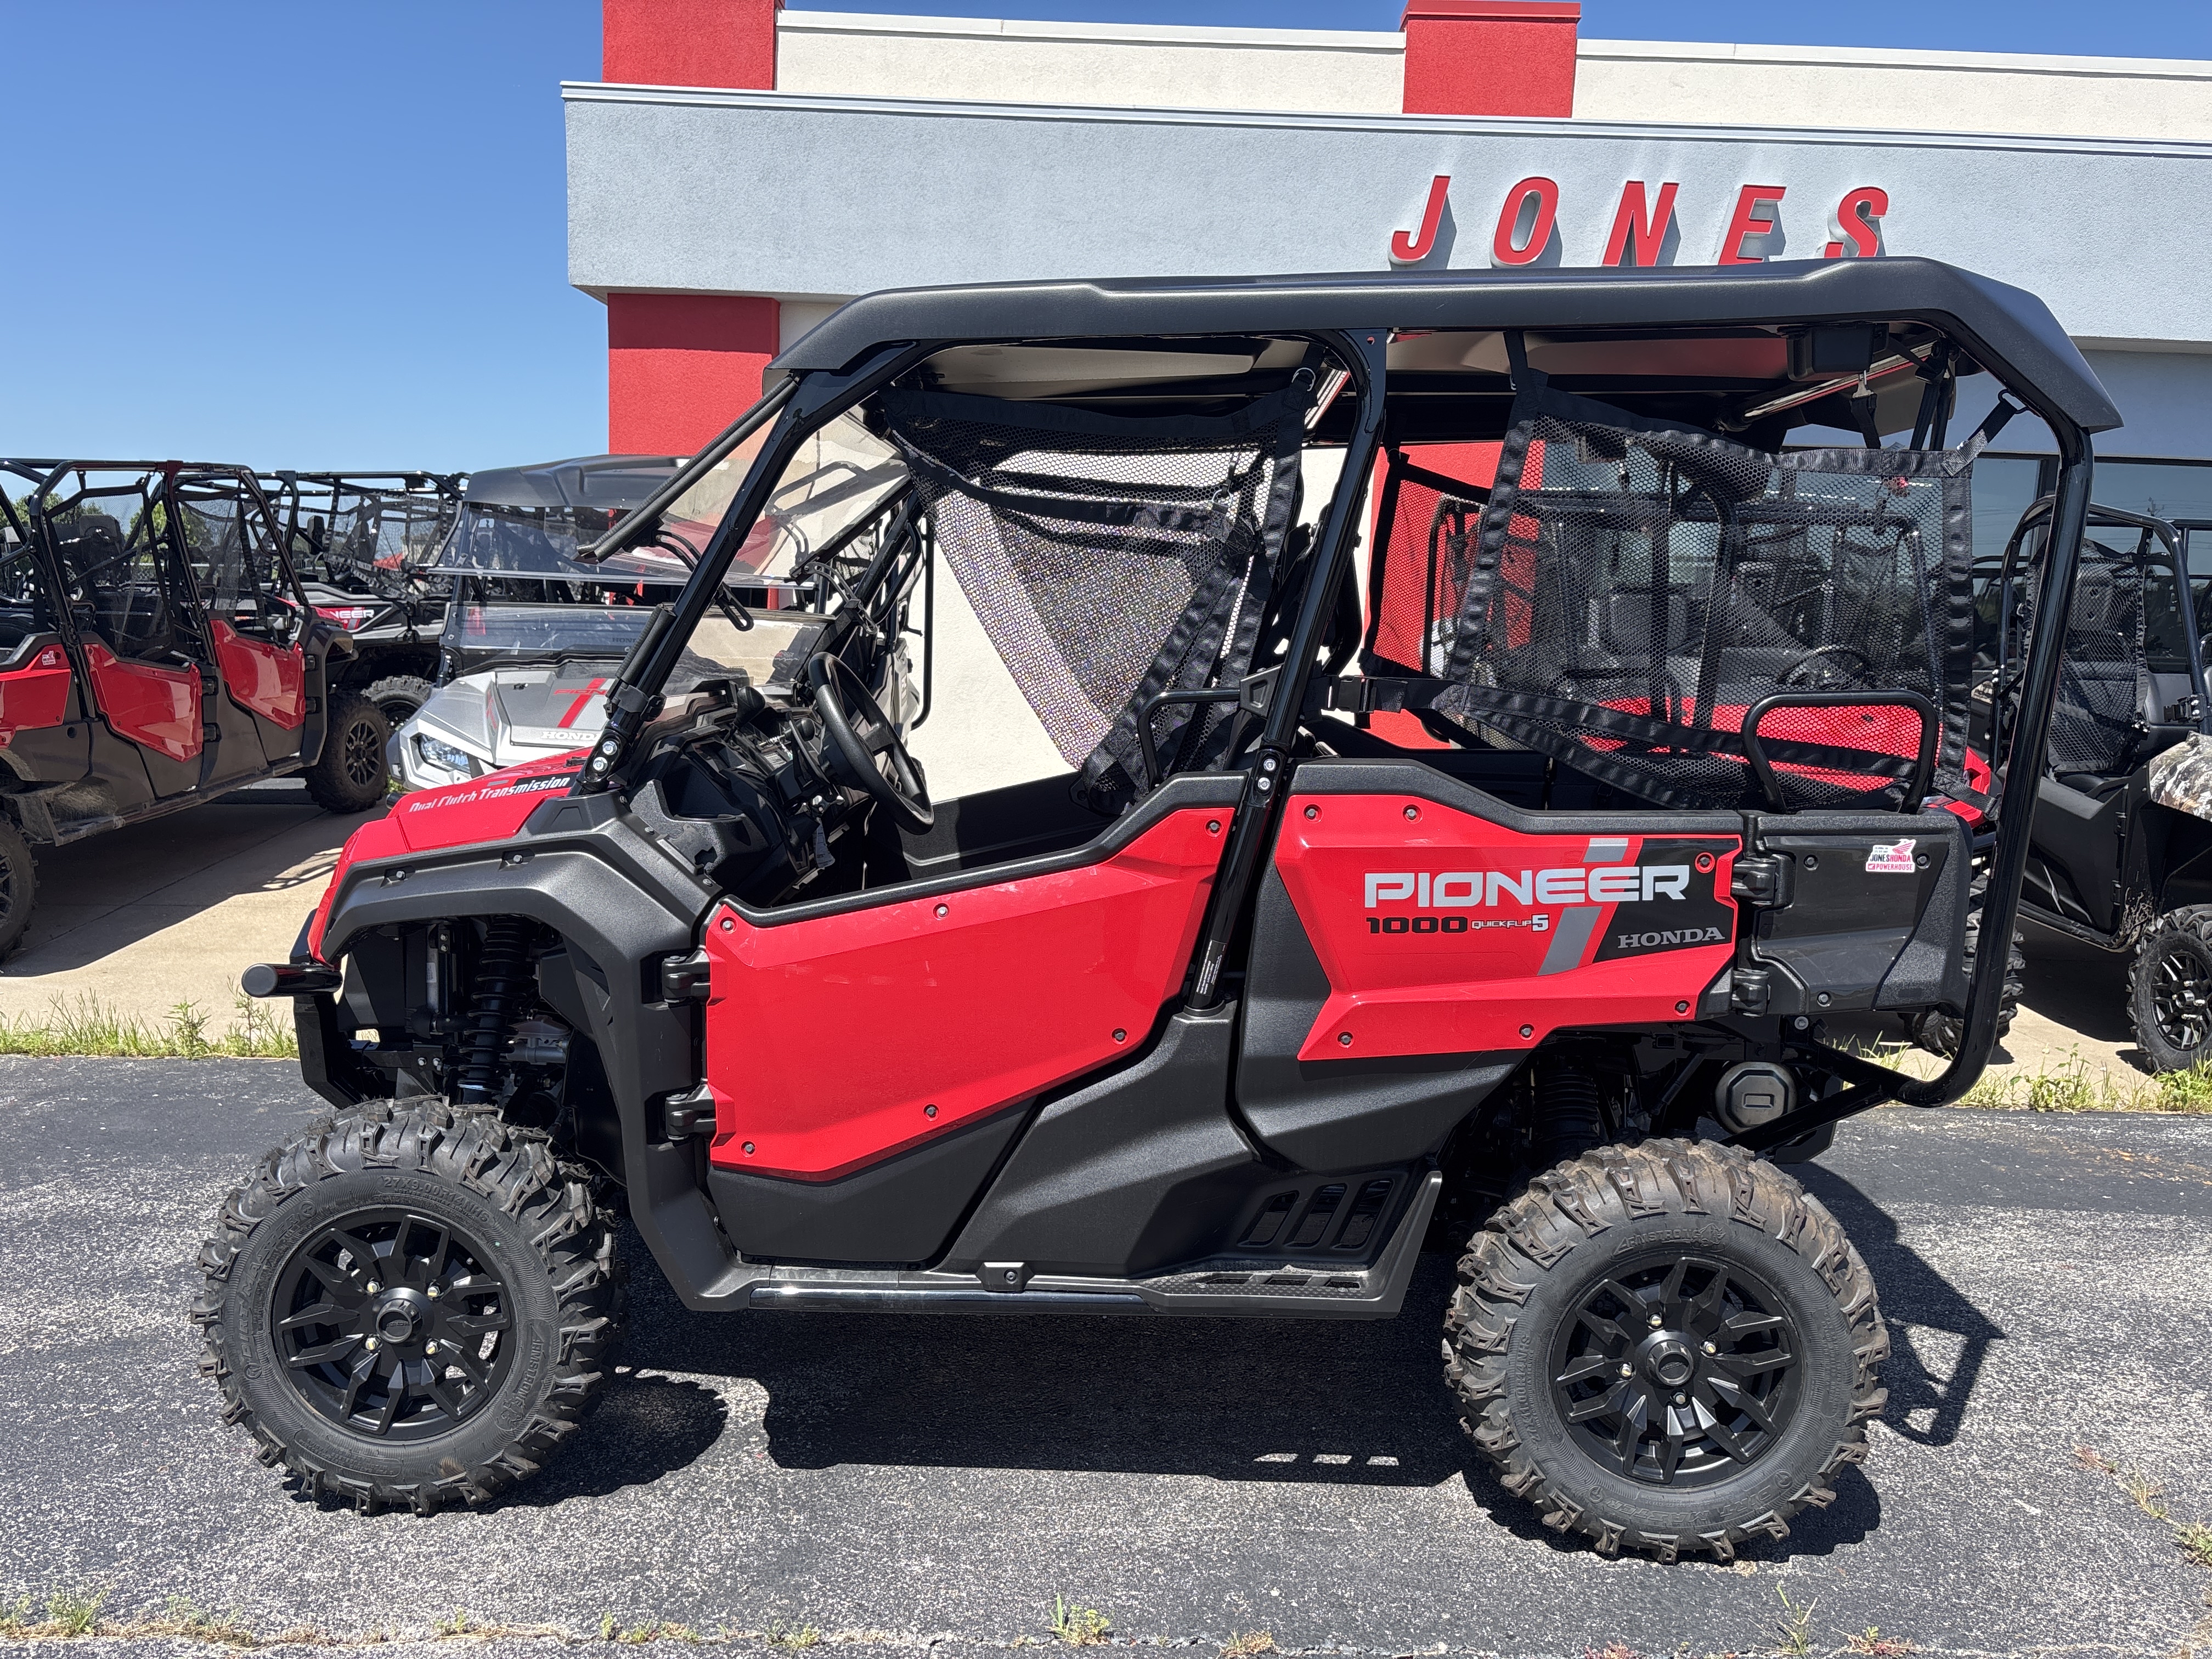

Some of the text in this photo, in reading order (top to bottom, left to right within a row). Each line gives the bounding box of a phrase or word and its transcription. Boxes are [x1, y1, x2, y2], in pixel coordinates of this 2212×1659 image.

[1391, 174, 1889, 266] JONES
[329, 609, 374, 619] NEER
[409, 776, 571, 812] Dual Clutch Transmission
[1364, 865, 1690, 908] PIONEER
[1367, 917, 1468, 934] 1000
[1617, 927, 1725, 949] HONDA
